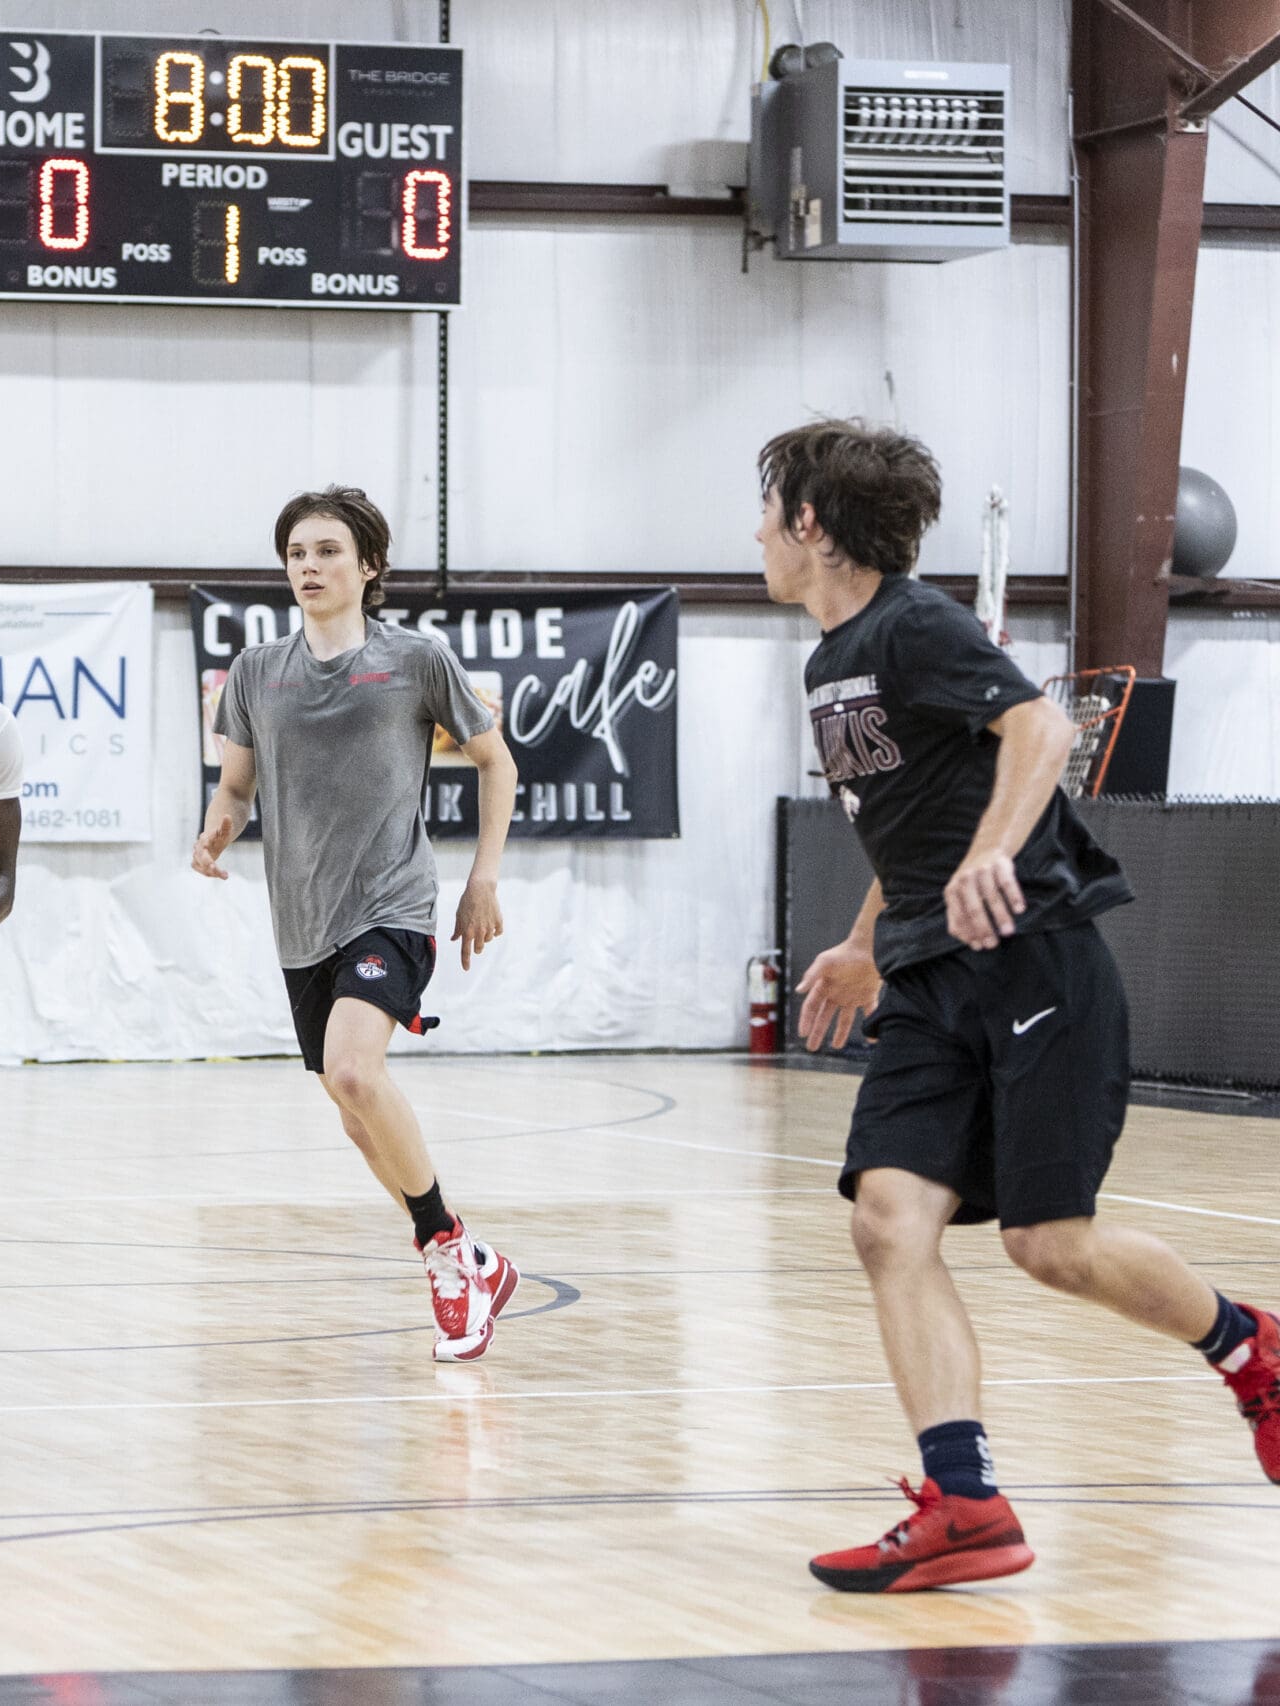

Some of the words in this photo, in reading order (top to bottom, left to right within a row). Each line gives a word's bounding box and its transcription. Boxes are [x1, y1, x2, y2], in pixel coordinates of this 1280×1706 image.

[348, 69, 381, 82] THE
[385, 70, 450, 84] BRIDGE
[154, 51, 326, 146] 8:00
[338, 122, 454, 161] GUEST
[162, 163, 269, 190] PERIOD
[38, 158, 90, 250] 0
[402, 170, 451, 260] 0
[122, 243, 172, 263] POSS
[225, 204, 240, 284] 1
[258, 246, 307, 267] POSS
[27, 265, 118, 290] BONUS
[311, 273, 400, 297] BONUS
[203, 603, 566, 660] COTSIDE
